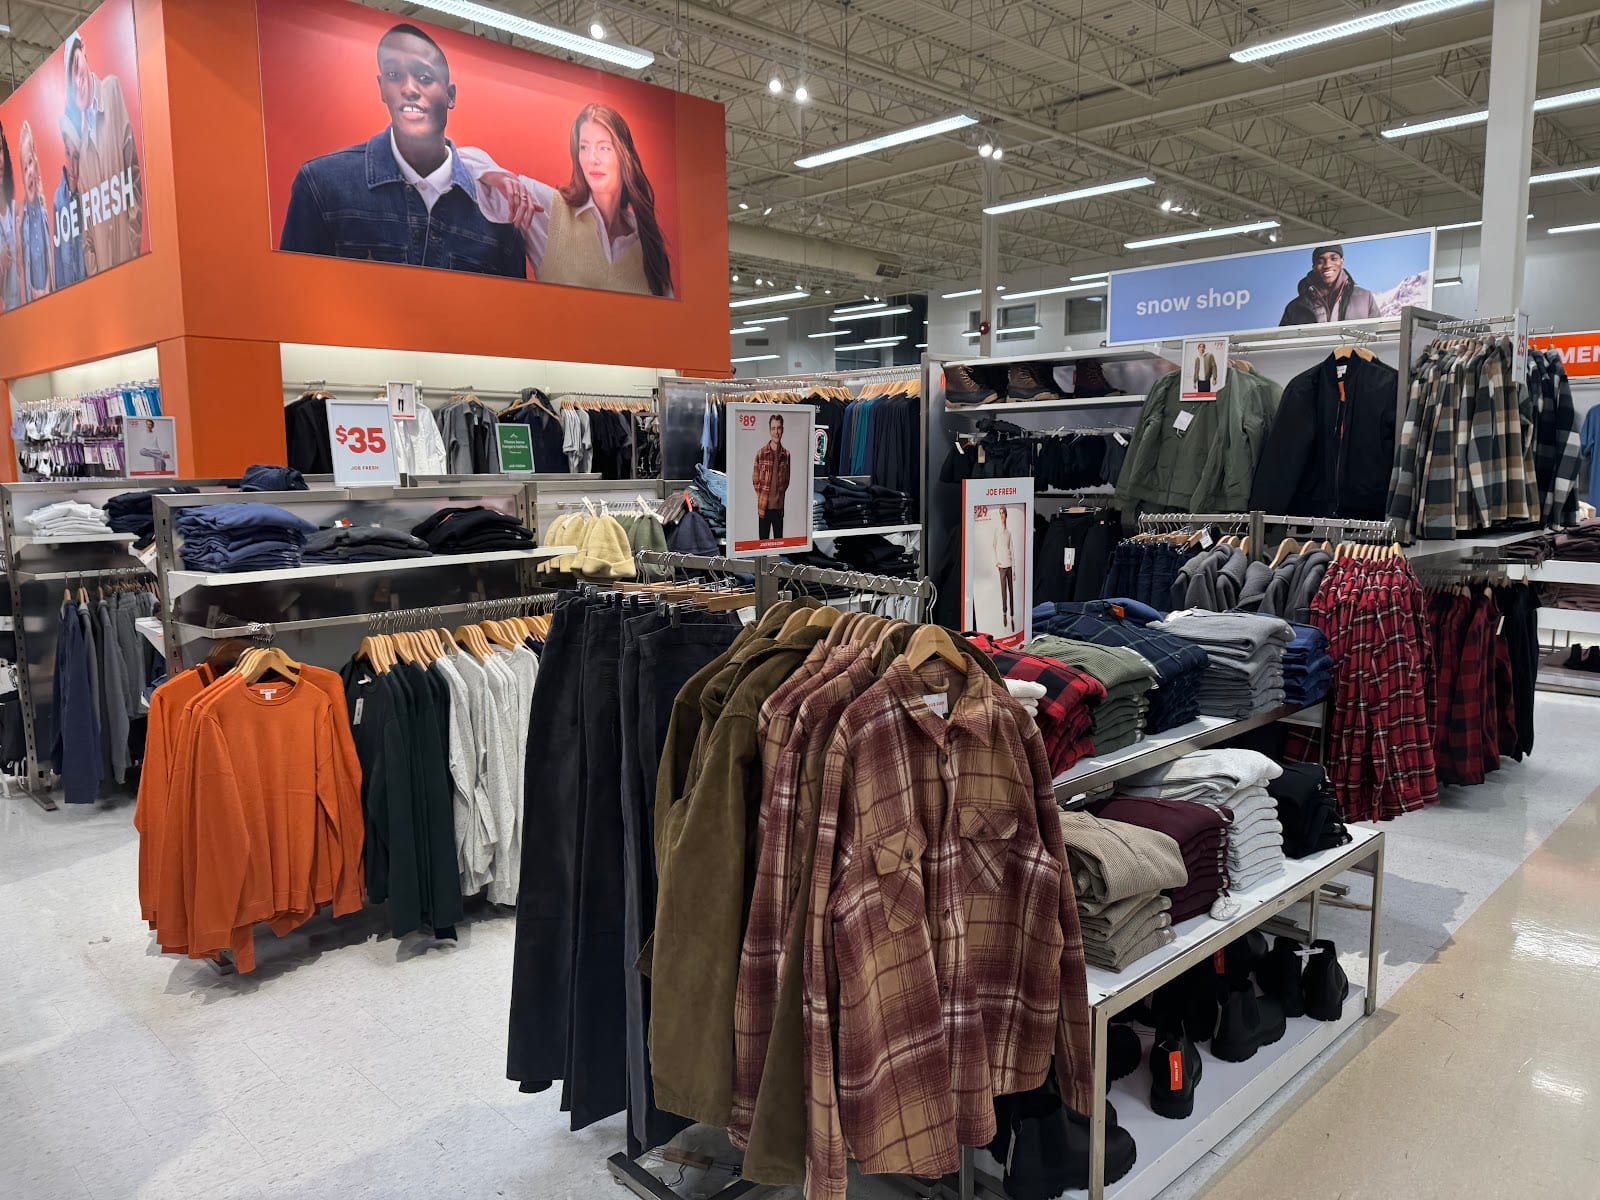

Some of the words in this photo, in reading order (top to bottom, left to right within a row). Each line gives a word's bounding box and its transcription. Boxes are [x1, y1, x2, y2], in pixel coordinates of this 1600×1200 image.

[53, 199, 80, 248] JOE
[81, 166, 135, 231] FRESH
[1136, 295, 1191, 316] snow
[1196, 287, 1250, 310] shop
[739, 414, 756, 427] $89
[335, 425, 387, 454] $35
[986, 488, 997, 496] JOE
[998, 487, 1017, 496] FRESH
